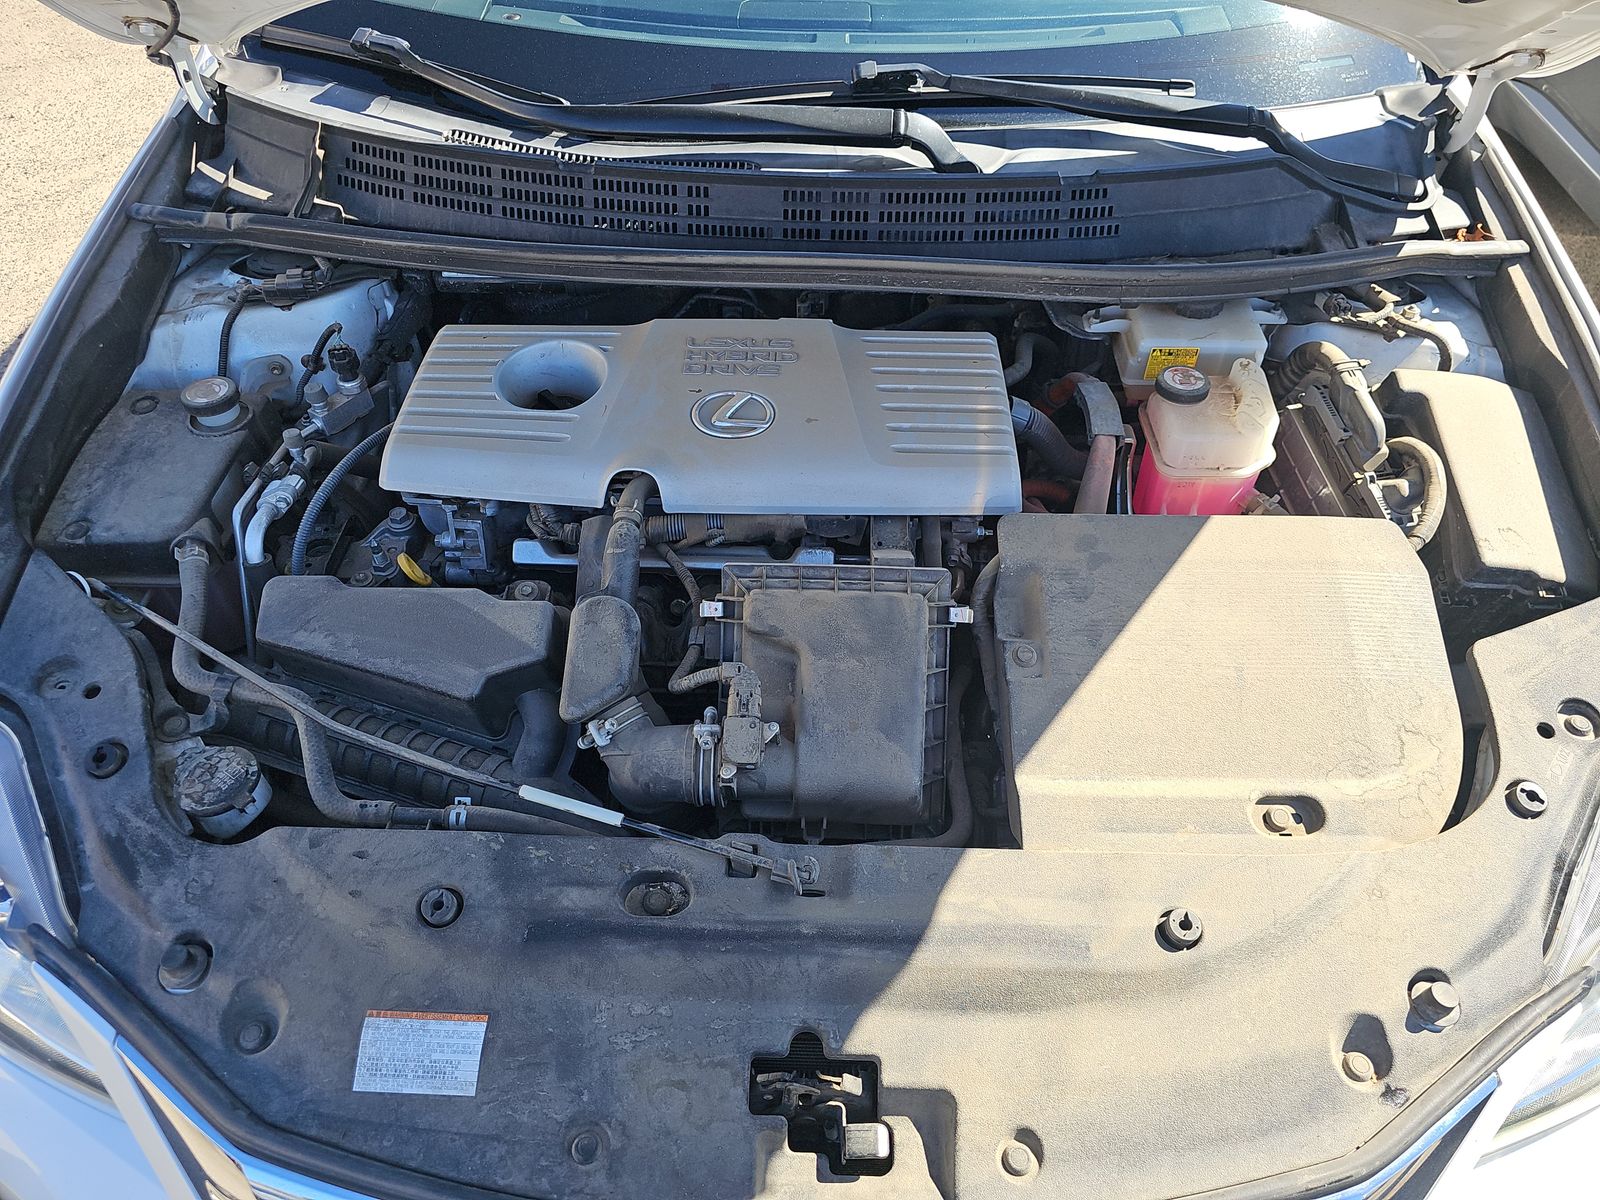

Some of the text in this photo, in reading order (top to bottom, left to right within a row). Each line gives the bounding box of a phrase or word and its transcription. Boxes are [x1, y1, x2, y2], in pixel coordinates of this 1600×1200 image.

[685, 336, 794, 350] LEXUS
[684, 349, 799, 363] HYBRID
[682, 362, 781, 377] DRIVE
